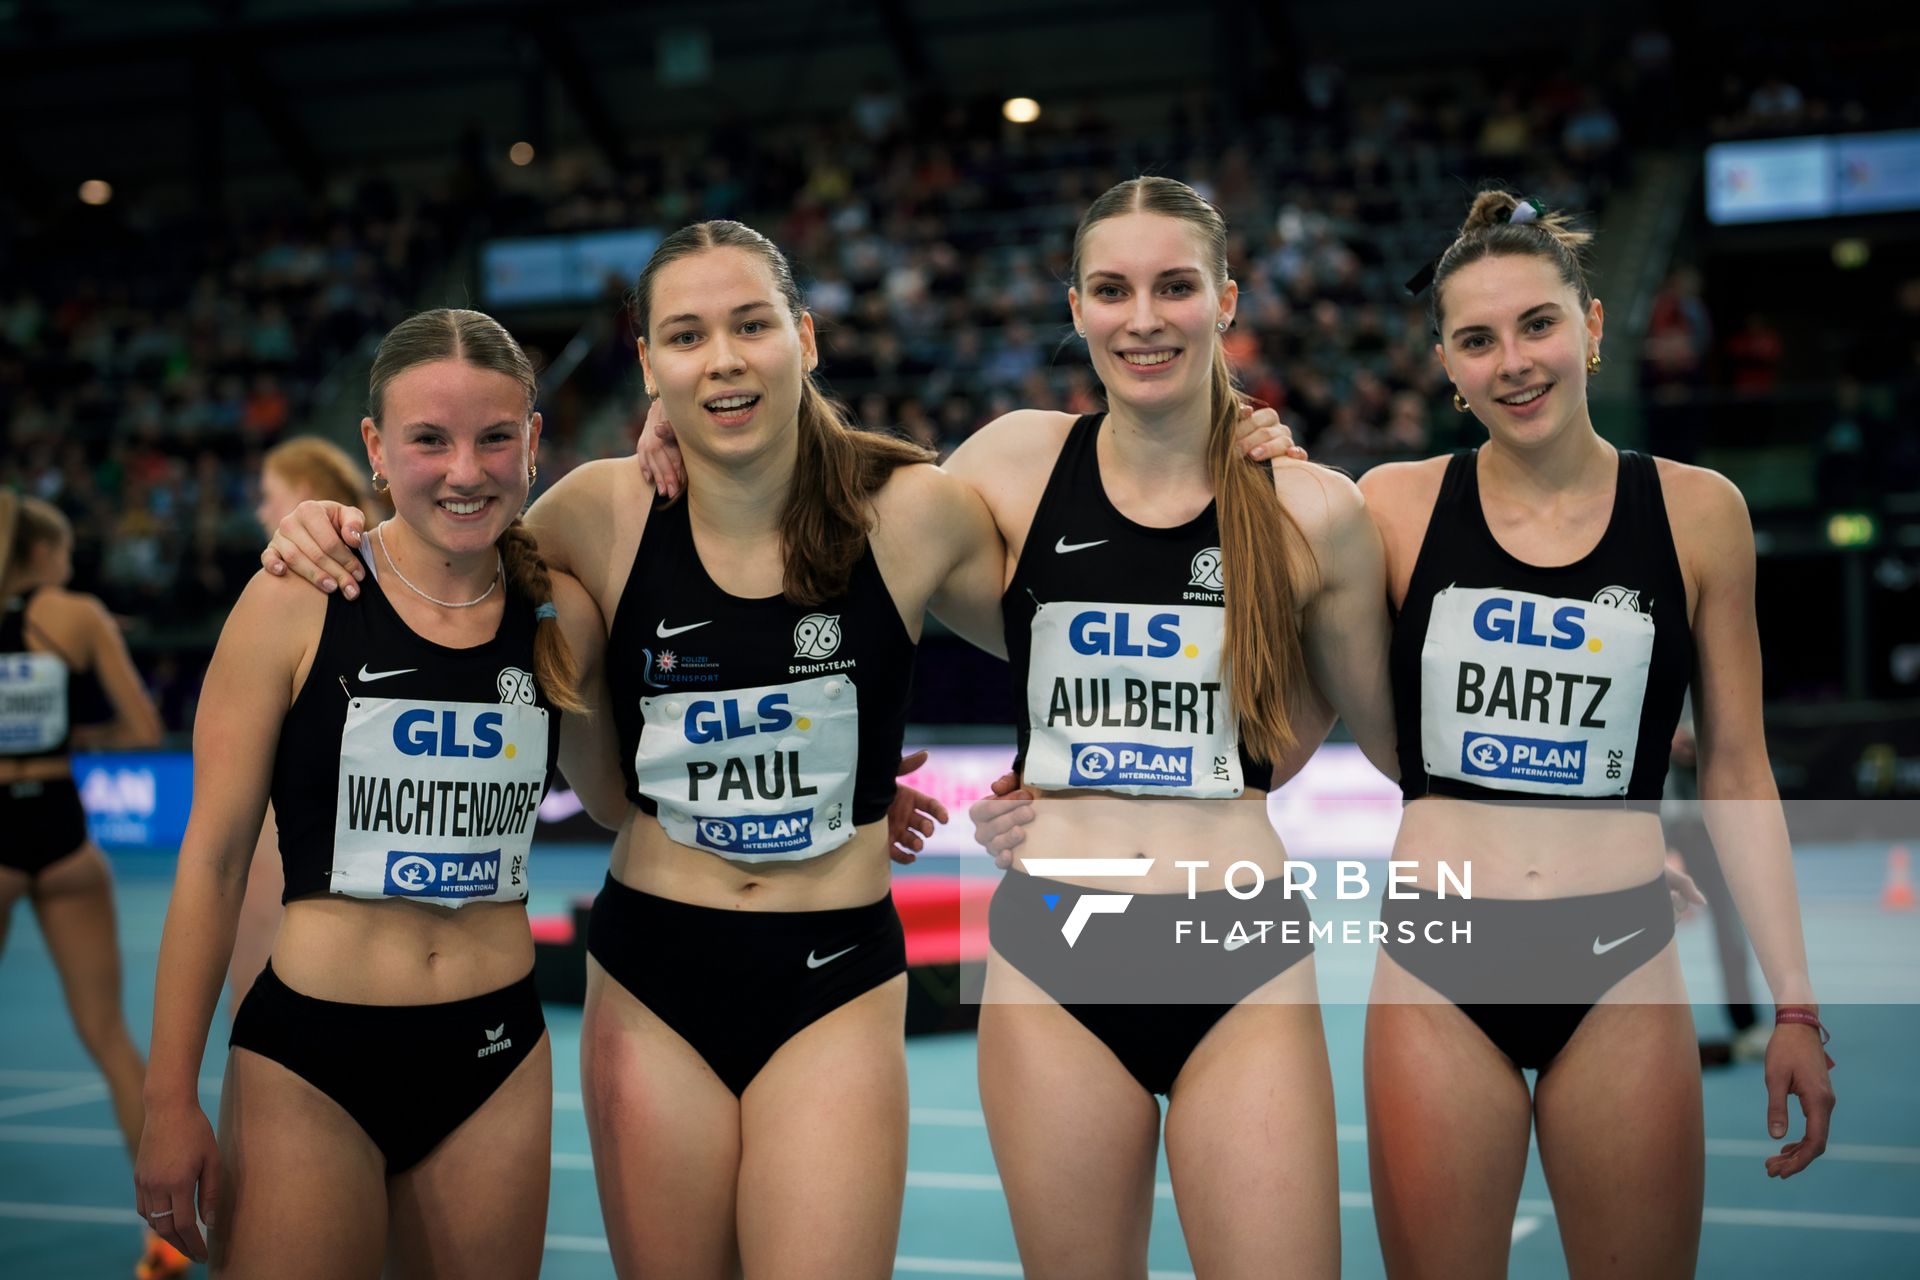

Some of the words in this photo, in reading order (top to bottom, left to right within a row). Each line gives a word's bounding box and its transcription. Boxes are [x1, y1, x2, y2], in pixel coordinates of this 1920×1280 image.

[796, 615, 839, 658] 96
[1069, 610, 1199, 659] GLS.
[1473, 597, 1603, 653] GLS.
[654, 674, 719, 682] SPITZENSPORT
[789, 659, 856, 674] SPRINT-TEAM
[499, 669, 535, 705] 96
[1456, 661, 1612, 729] BARTZ
[684, 693, 812, 744] GLS.
[1047, 676, 1220, 735] AULBERT
[392, 708, 517, 759] GLS.
[1119, 749, 1187, 773] PLAN
[1213, 756, 1230, 782] 247
[1512, 745, 1581, 770] PLAN
[1606, 749, 1623, 780] 248
[686, 750, 818, 801] PAUL
[1119, 772, 1187, 782] INTERNATIONAL
[1511, 767, 1579, 780] INTERNATIONAL
[348, 774, 541, 837] WACHTENDORF
[742, 816, 808, 840] PLAN
[742, 837, 807, 850] INTERNATIONAL
[441, 860, 497, 882] PLAN
[511, 855, 522, 886] 254
[440, 884, 495, 892] INTERNATIONAL
[477, 1038, 512, 1058] erima
